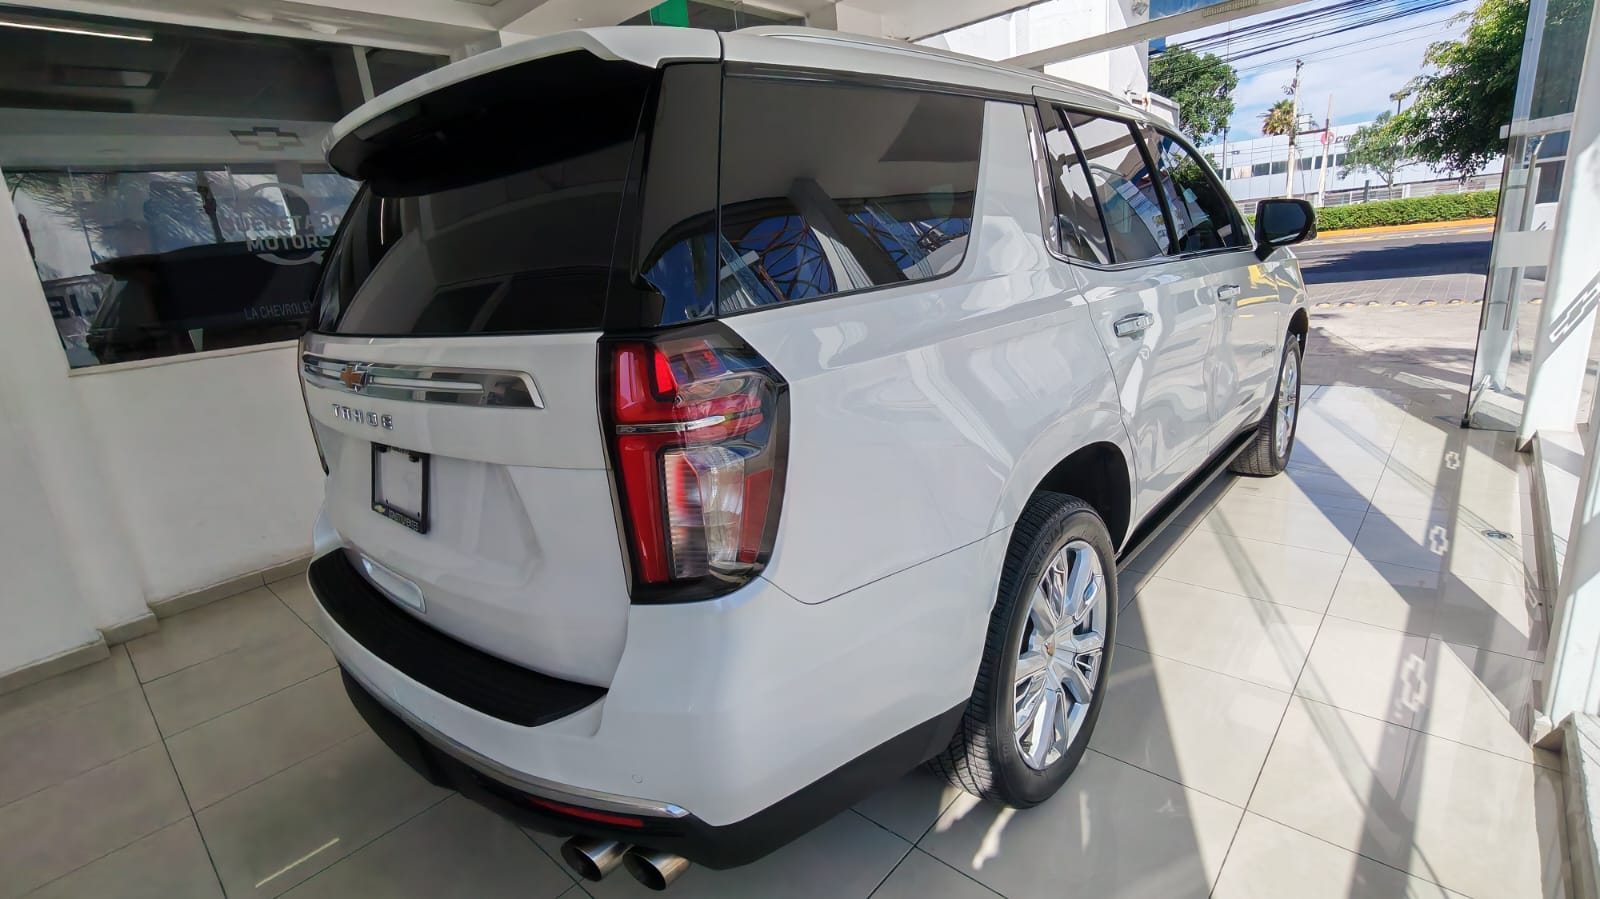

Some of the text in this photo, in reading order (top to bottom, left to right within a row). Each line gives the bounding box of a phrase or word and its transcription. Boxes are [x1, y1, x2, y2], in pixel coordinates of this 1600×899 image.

[246, 234, 331, 252] MOTORS
[244, 305, 259, 320] LA
[331, 403, 393, 430] TAHOE
